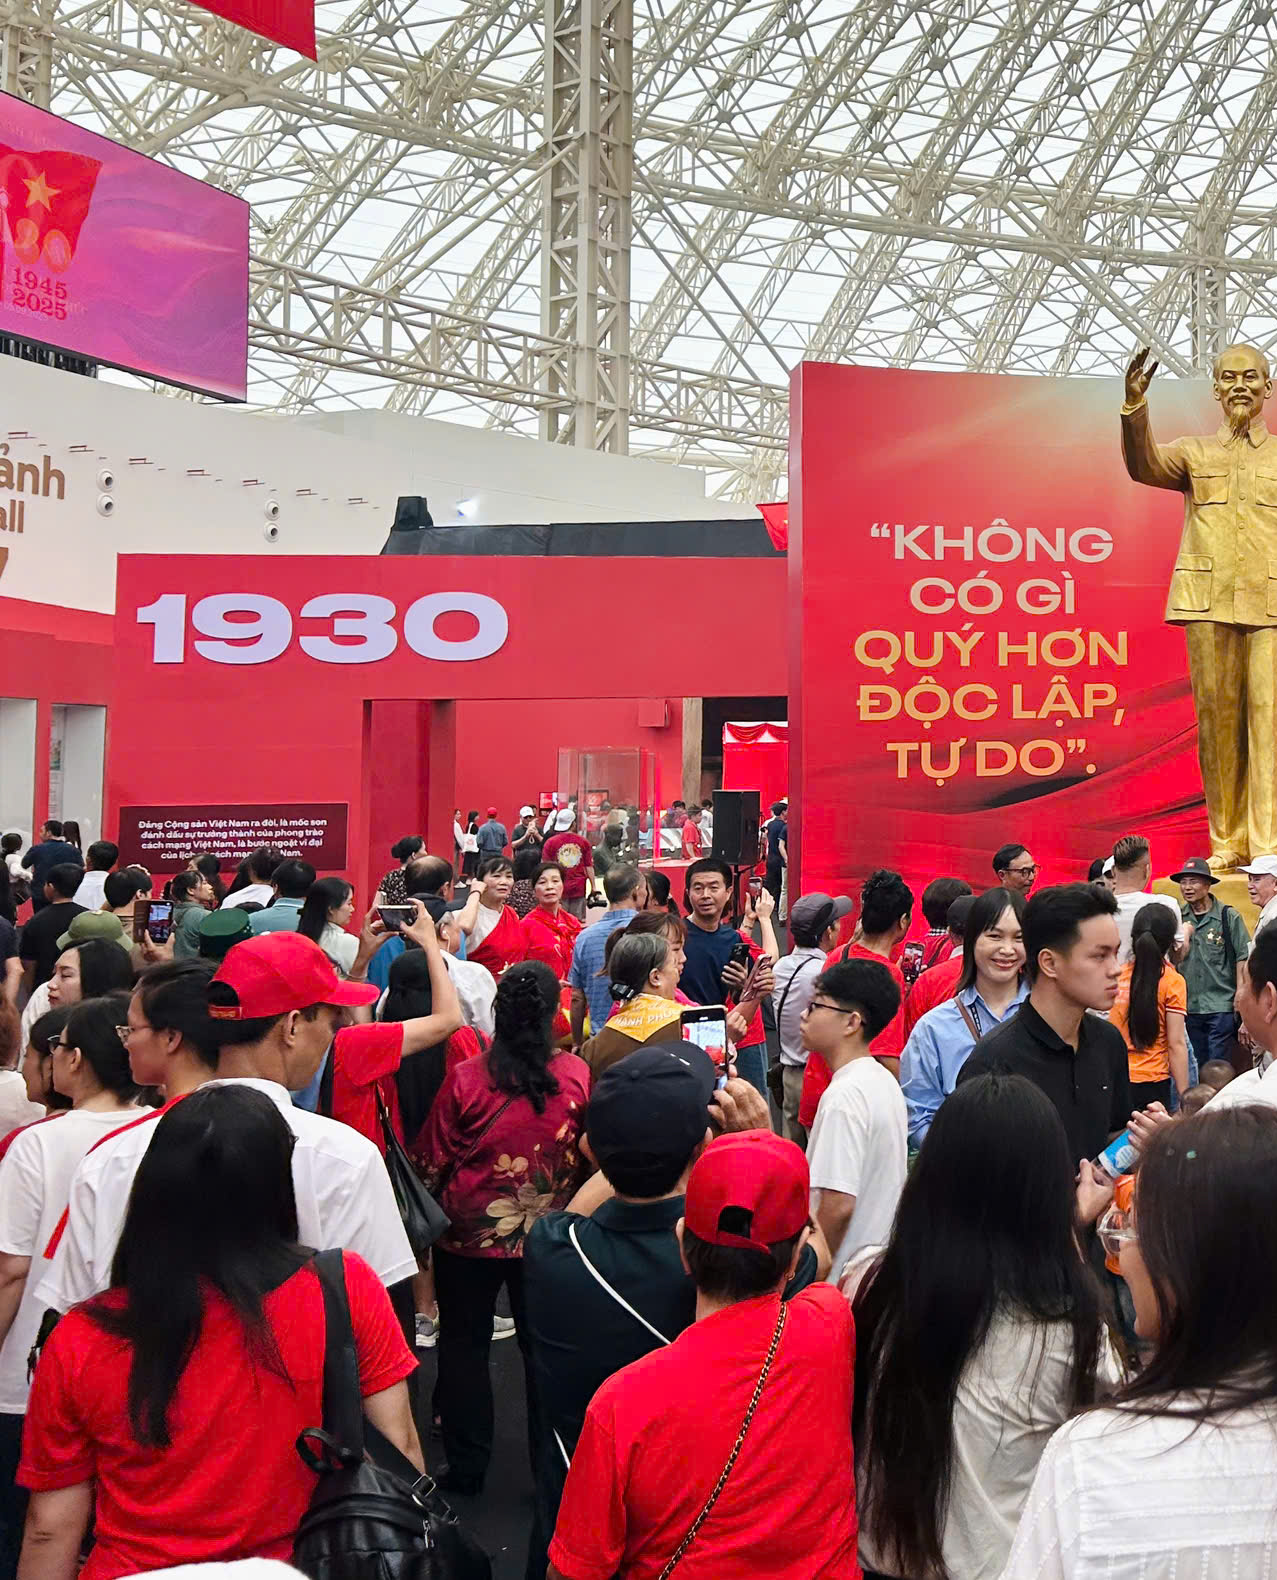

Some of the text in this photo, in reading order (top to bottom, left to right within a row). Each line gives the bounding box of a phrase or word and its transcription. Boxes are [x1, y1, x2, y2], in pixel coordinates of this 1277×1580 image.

[13, 267, 67, 300] 1945
[12, 287, 67, 320] 2025
[910, 570, 1075, 614] CÓ GÌ
[136, 591, 509, 664] 1930
[854, 622, 1129, 675] QUÝ HƠN
[856, 675, 1125, 729] ĐỘC LẬP,
[886, 737, 966, 786] TỰ
[141, 830, 164, 839] đánh
[229, 829, 255, 838] thành
[257, 829, 273, 837] của
[274, 829, 304, 838] phong
[305, 828, 324, 836] trào
[164, 820, 189, 829] Cộng
[208, 819, 227, 828] Việt
[229, 819, 249, 827] Nam
[280, 818, 288, 826] là
[289, 818, 309, 826] mốc
[141, 840, 164, 849] cách
[165, 842, 191, 850] mạng
[192, 840, 211, 849] Việt
[238, 839, 246, 847] là
[308, 838, 323, 848] đại
